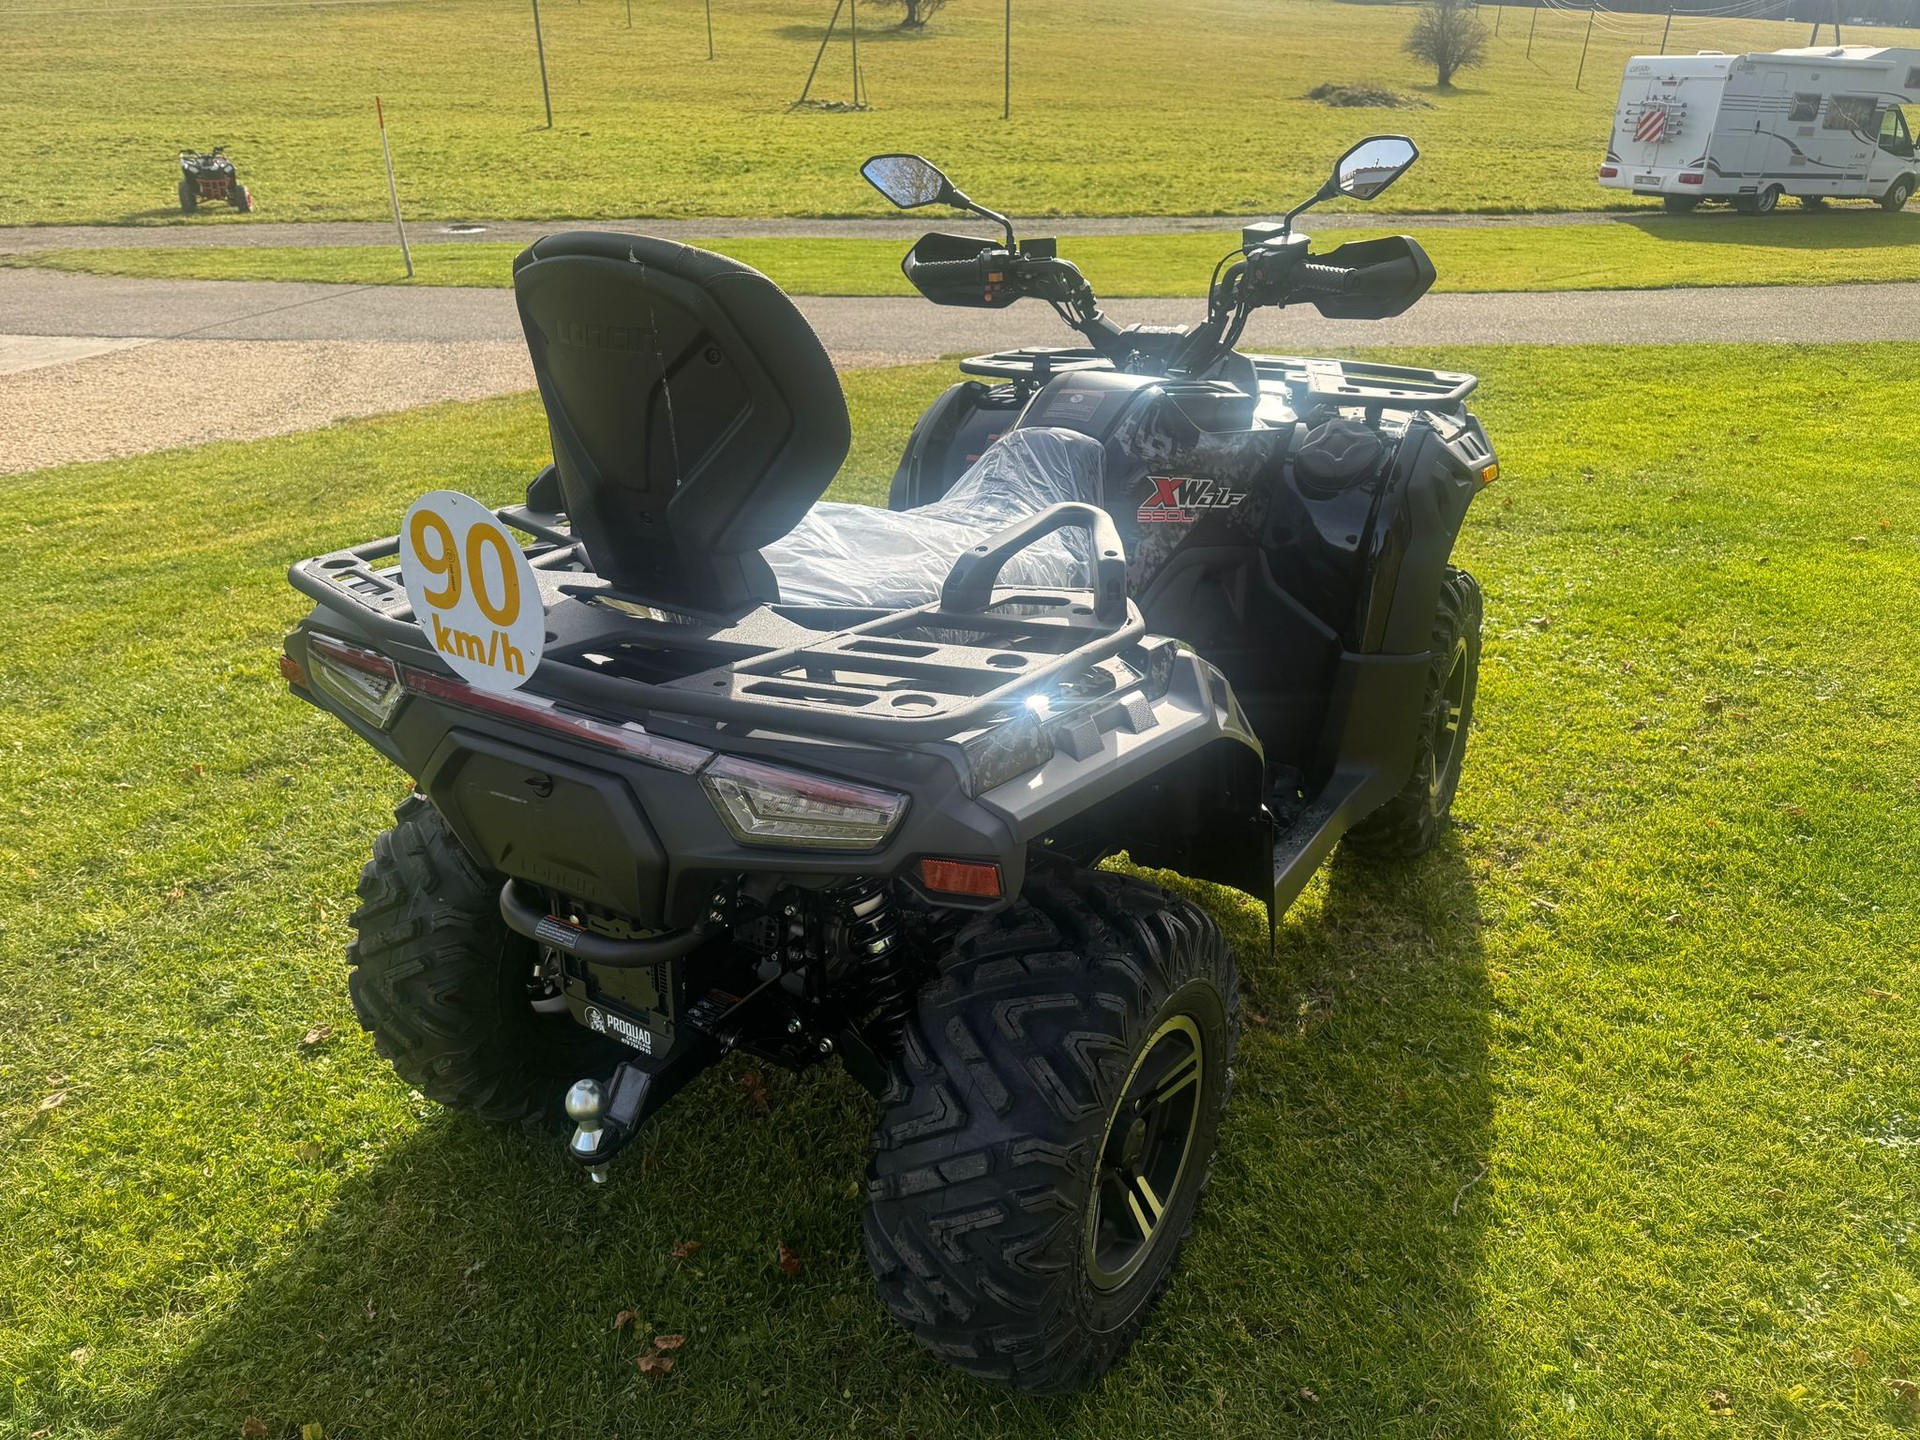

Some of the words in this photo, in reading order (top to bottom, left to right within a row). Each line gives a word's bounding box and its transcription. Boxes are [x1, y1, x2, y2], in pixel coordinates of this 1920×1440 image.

[410, 509, 521, 627] 90
[431, 612, 526, 676] km/h
[607, 1014, 651, 1045] PROQUAD
